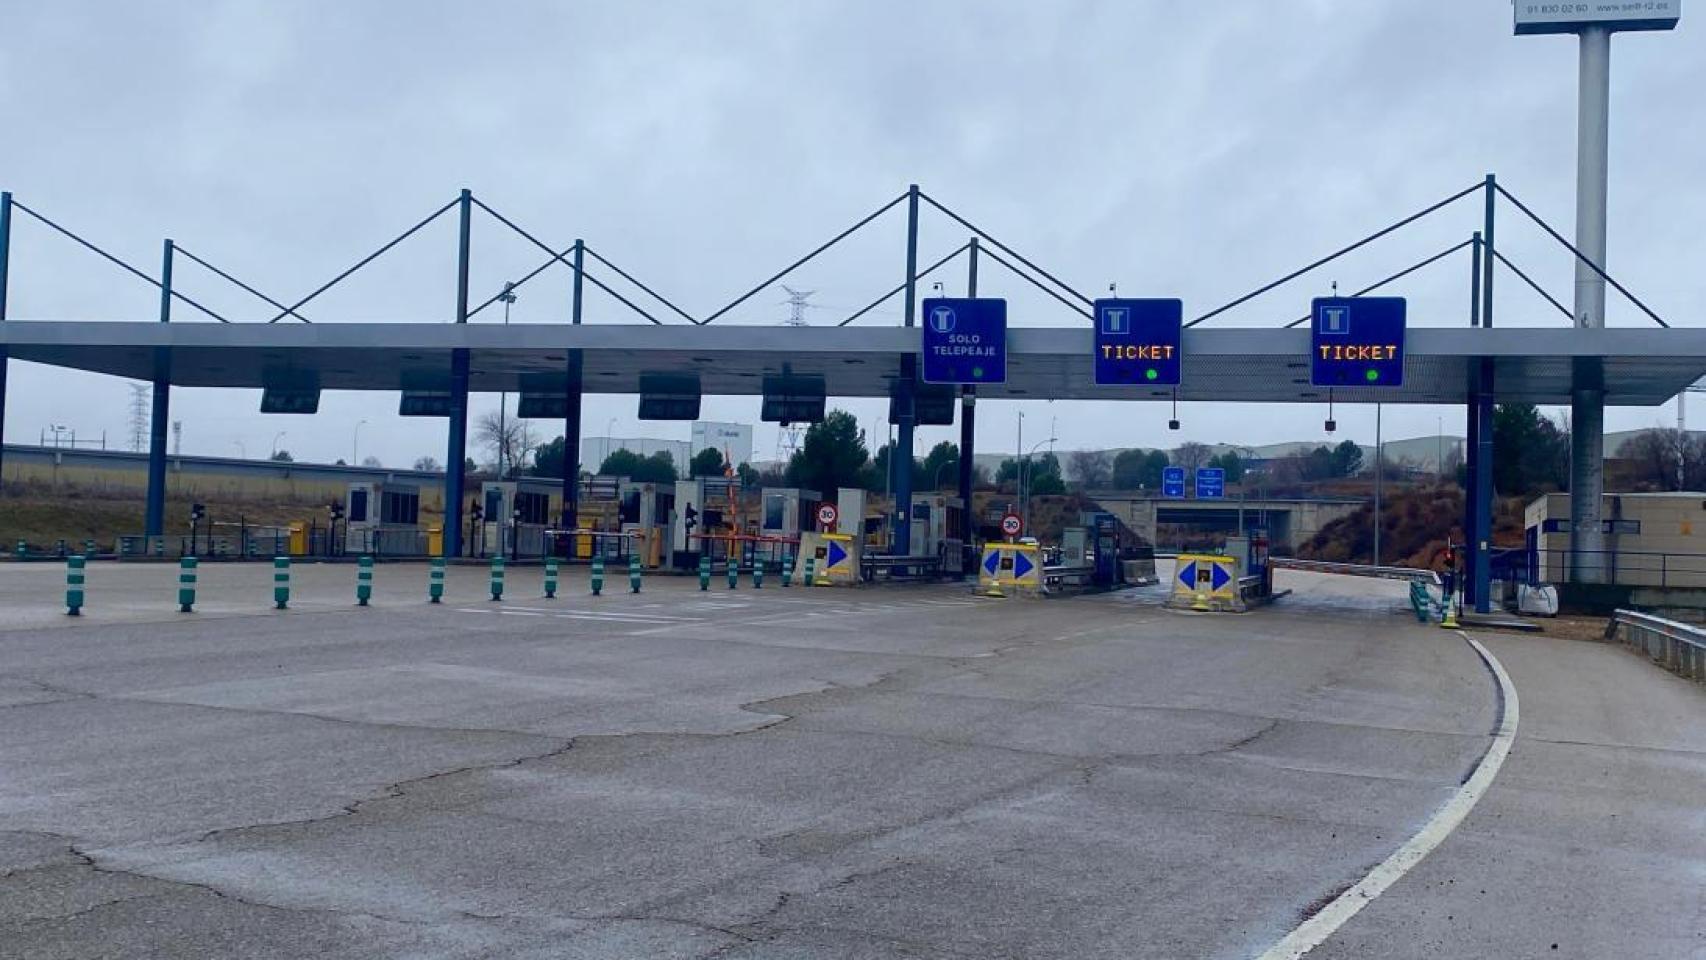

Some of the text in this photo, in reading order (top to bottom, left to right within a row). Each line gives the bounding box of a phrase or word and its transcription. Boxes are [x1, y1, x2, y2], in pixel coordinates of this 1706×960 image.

[948, 334, 980, 343] SOLO
[933, 346, 995, 356] TELEPEAJE
[1101, 344, 1175, 360] TICKET
[1319, 345, 1397, 360] TICKET
[821, 510, 833, 519] 30
[1004, 520, 1018, 530] 30
